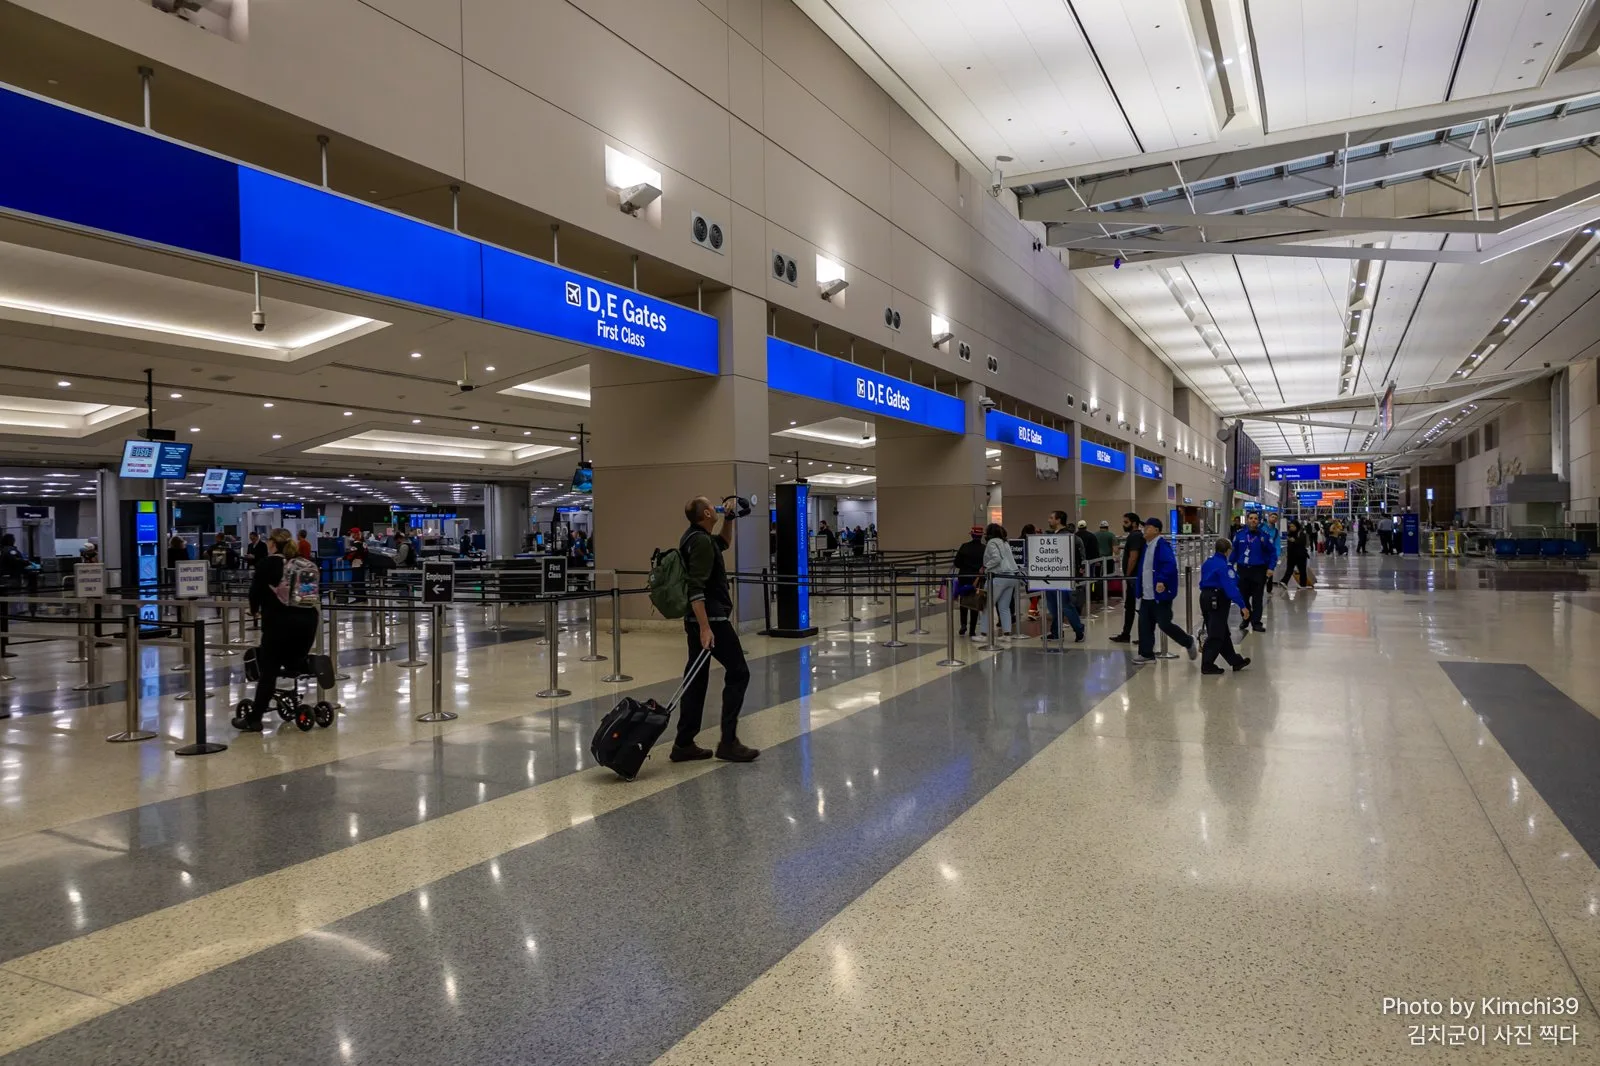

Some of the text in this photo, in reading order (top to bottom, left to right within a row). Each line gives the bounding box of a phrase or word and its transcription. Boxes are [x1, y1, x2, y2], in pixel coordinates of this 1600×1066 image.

[586, 286, 667, 332] D,E Gates
[597, 319, 646, 348] First Class
[867, 380, 911, 411] D,E Gates
[1035, 556, 1064, 564] Security
[549, 563, 561, 571] First
[1030, 564, 1069, 573] Checkpoint
[426, 572, 451, 581] Employees
[548, 571, 562, 579] Class
